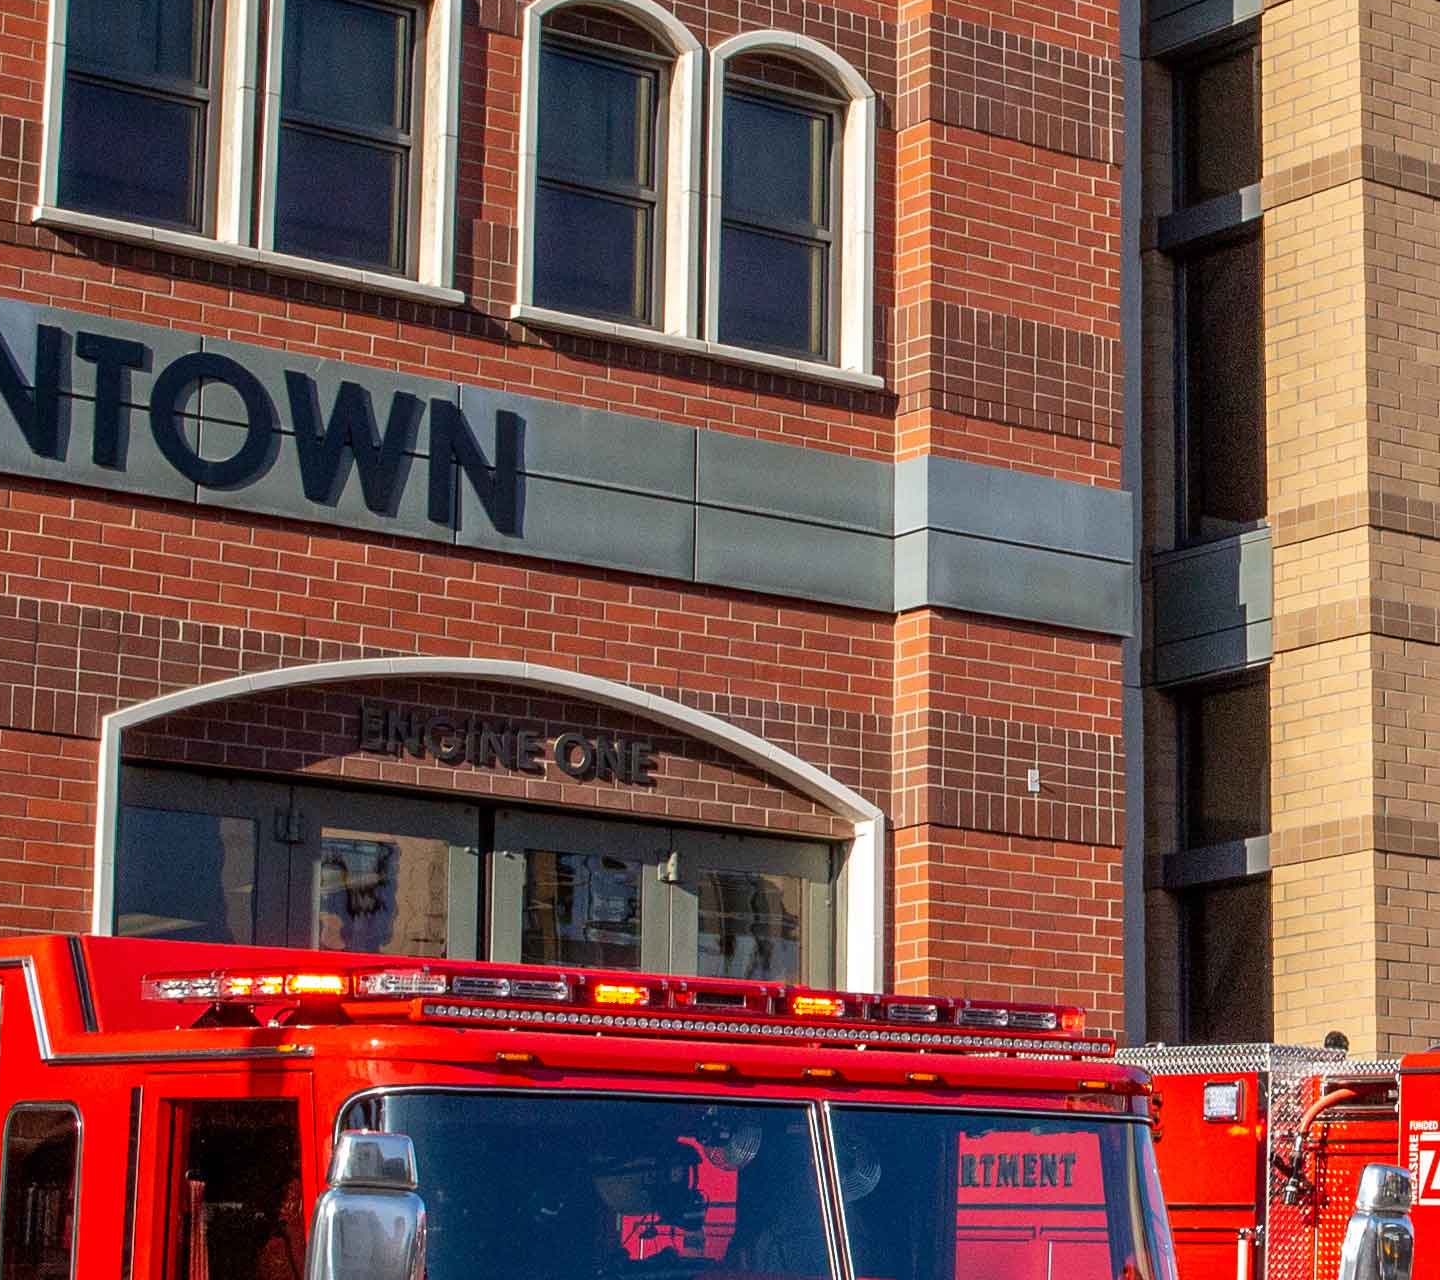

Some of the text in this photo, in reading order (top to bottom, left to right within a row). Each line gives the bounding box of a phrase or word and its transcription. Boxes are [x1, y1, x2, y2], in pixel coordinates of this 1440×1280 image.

[361, 696, 658, 786] ENGINE ONE
[1409, 1120, 1438, 1131] FUNDED
[960, 1152, 1076, 1187] RTMENT
[1409, 1134, 1419, 1206] MEASURE
